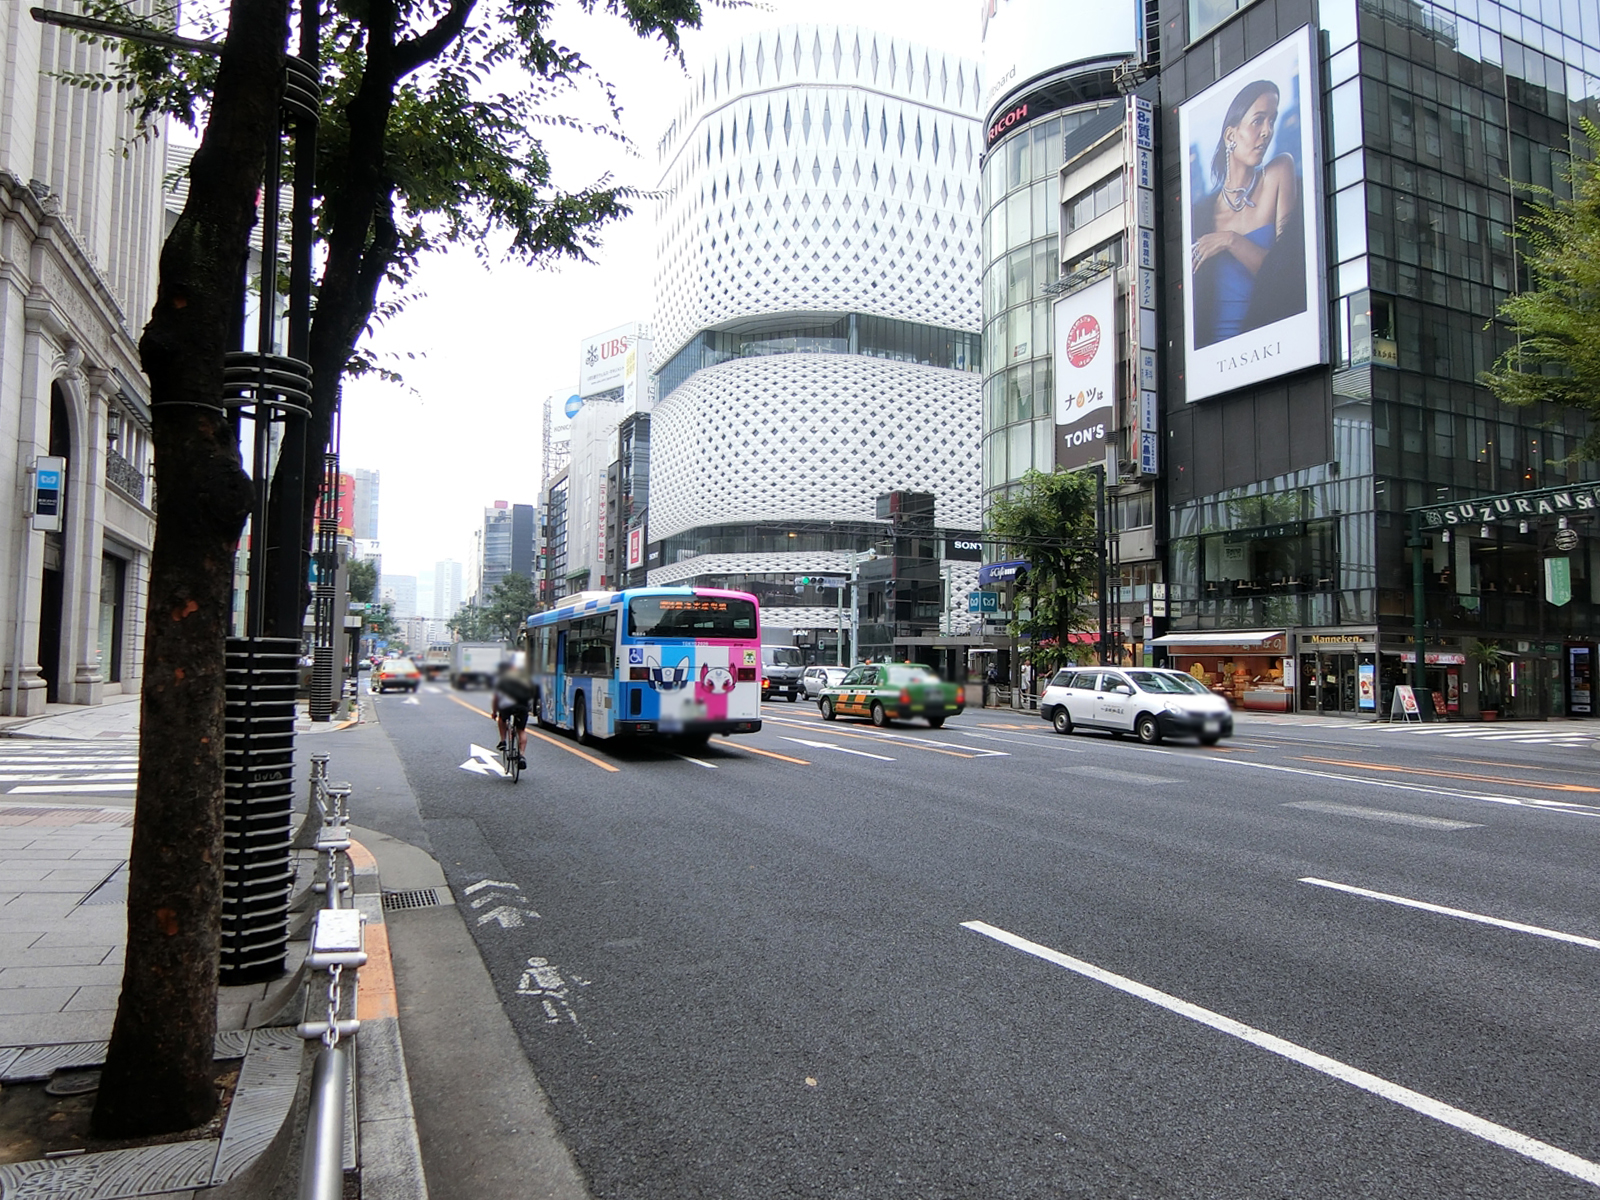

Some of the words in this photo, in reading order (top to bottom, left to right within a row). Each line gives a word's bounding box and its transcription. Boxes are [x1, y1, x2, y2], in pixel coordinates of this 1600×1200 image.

[988, 103, 1028, 142] RICOH
[1138, 123, 1151, 141] 質
[600, 335, 628, 361] UBS
[1216, 341, 1281, 373] TASAKI
[1144, 356, 1154, 380] 歯科
[553, 424, 572, 433] KONIC
[1064, 424, 1105, 448] TON'S
[1445, 493, 1572, 524] SUZURAN
[954, 541, 983, 551] SONY
[1311, 635, 1360, 643] Manneken
